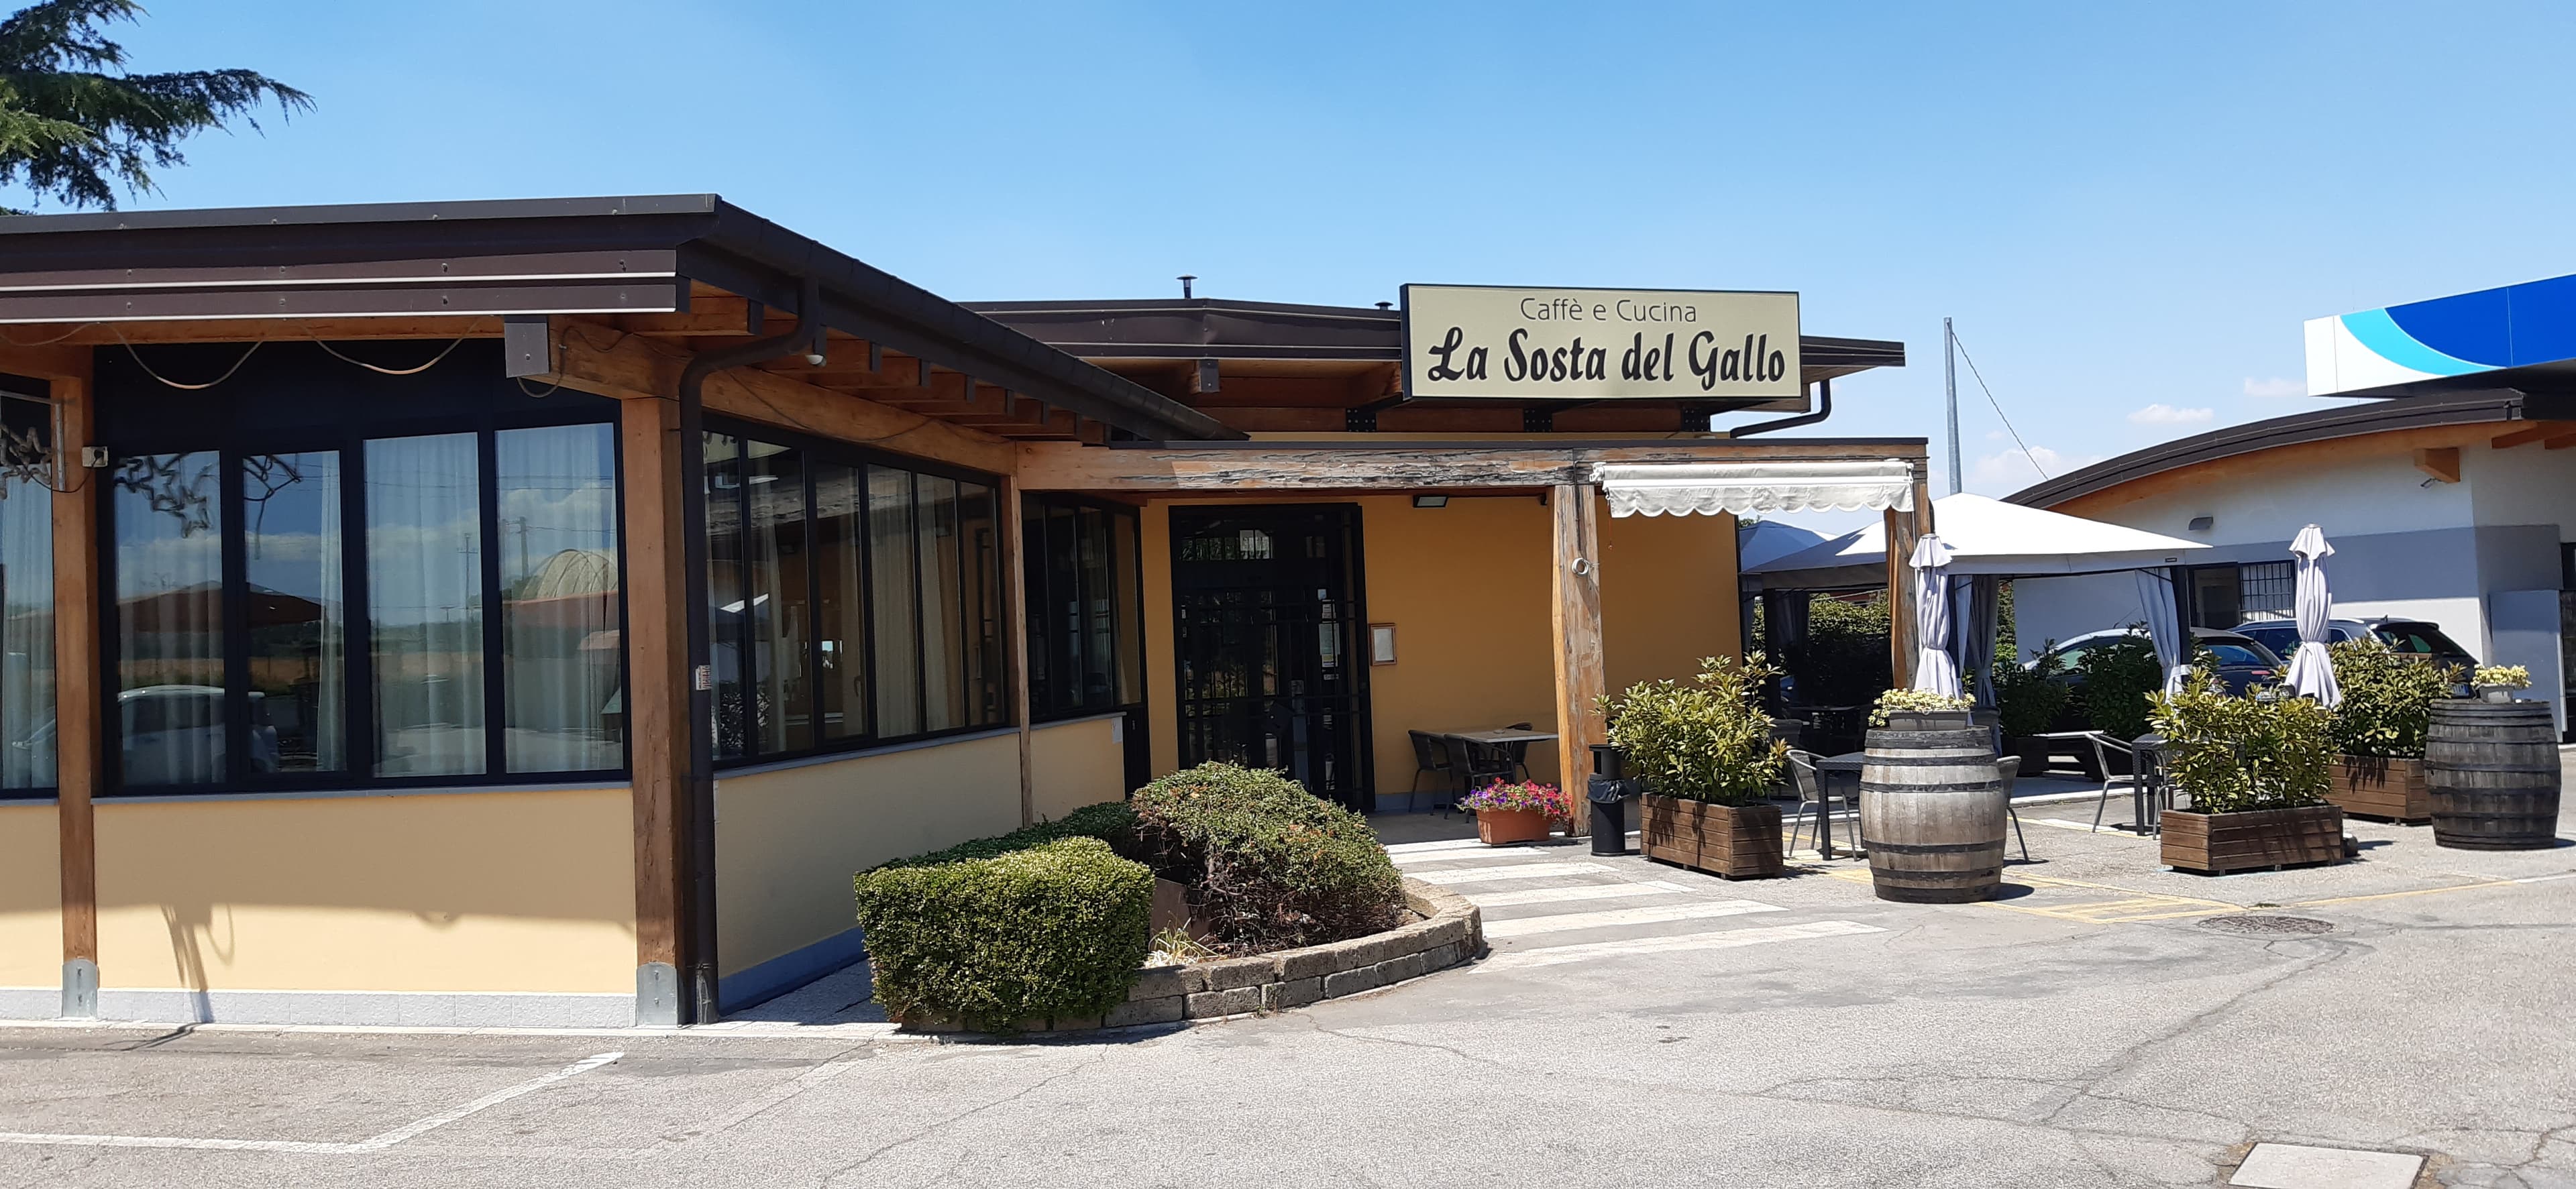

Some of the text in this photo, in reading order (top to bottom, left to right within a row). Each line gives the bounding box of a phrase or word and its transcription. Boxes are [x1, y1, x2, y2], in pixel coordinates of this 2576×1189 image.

[1521, 298, 1697, 323] Caffè e Cucina
[1428, 327, 1786, 392] La Sosta del Gallo
